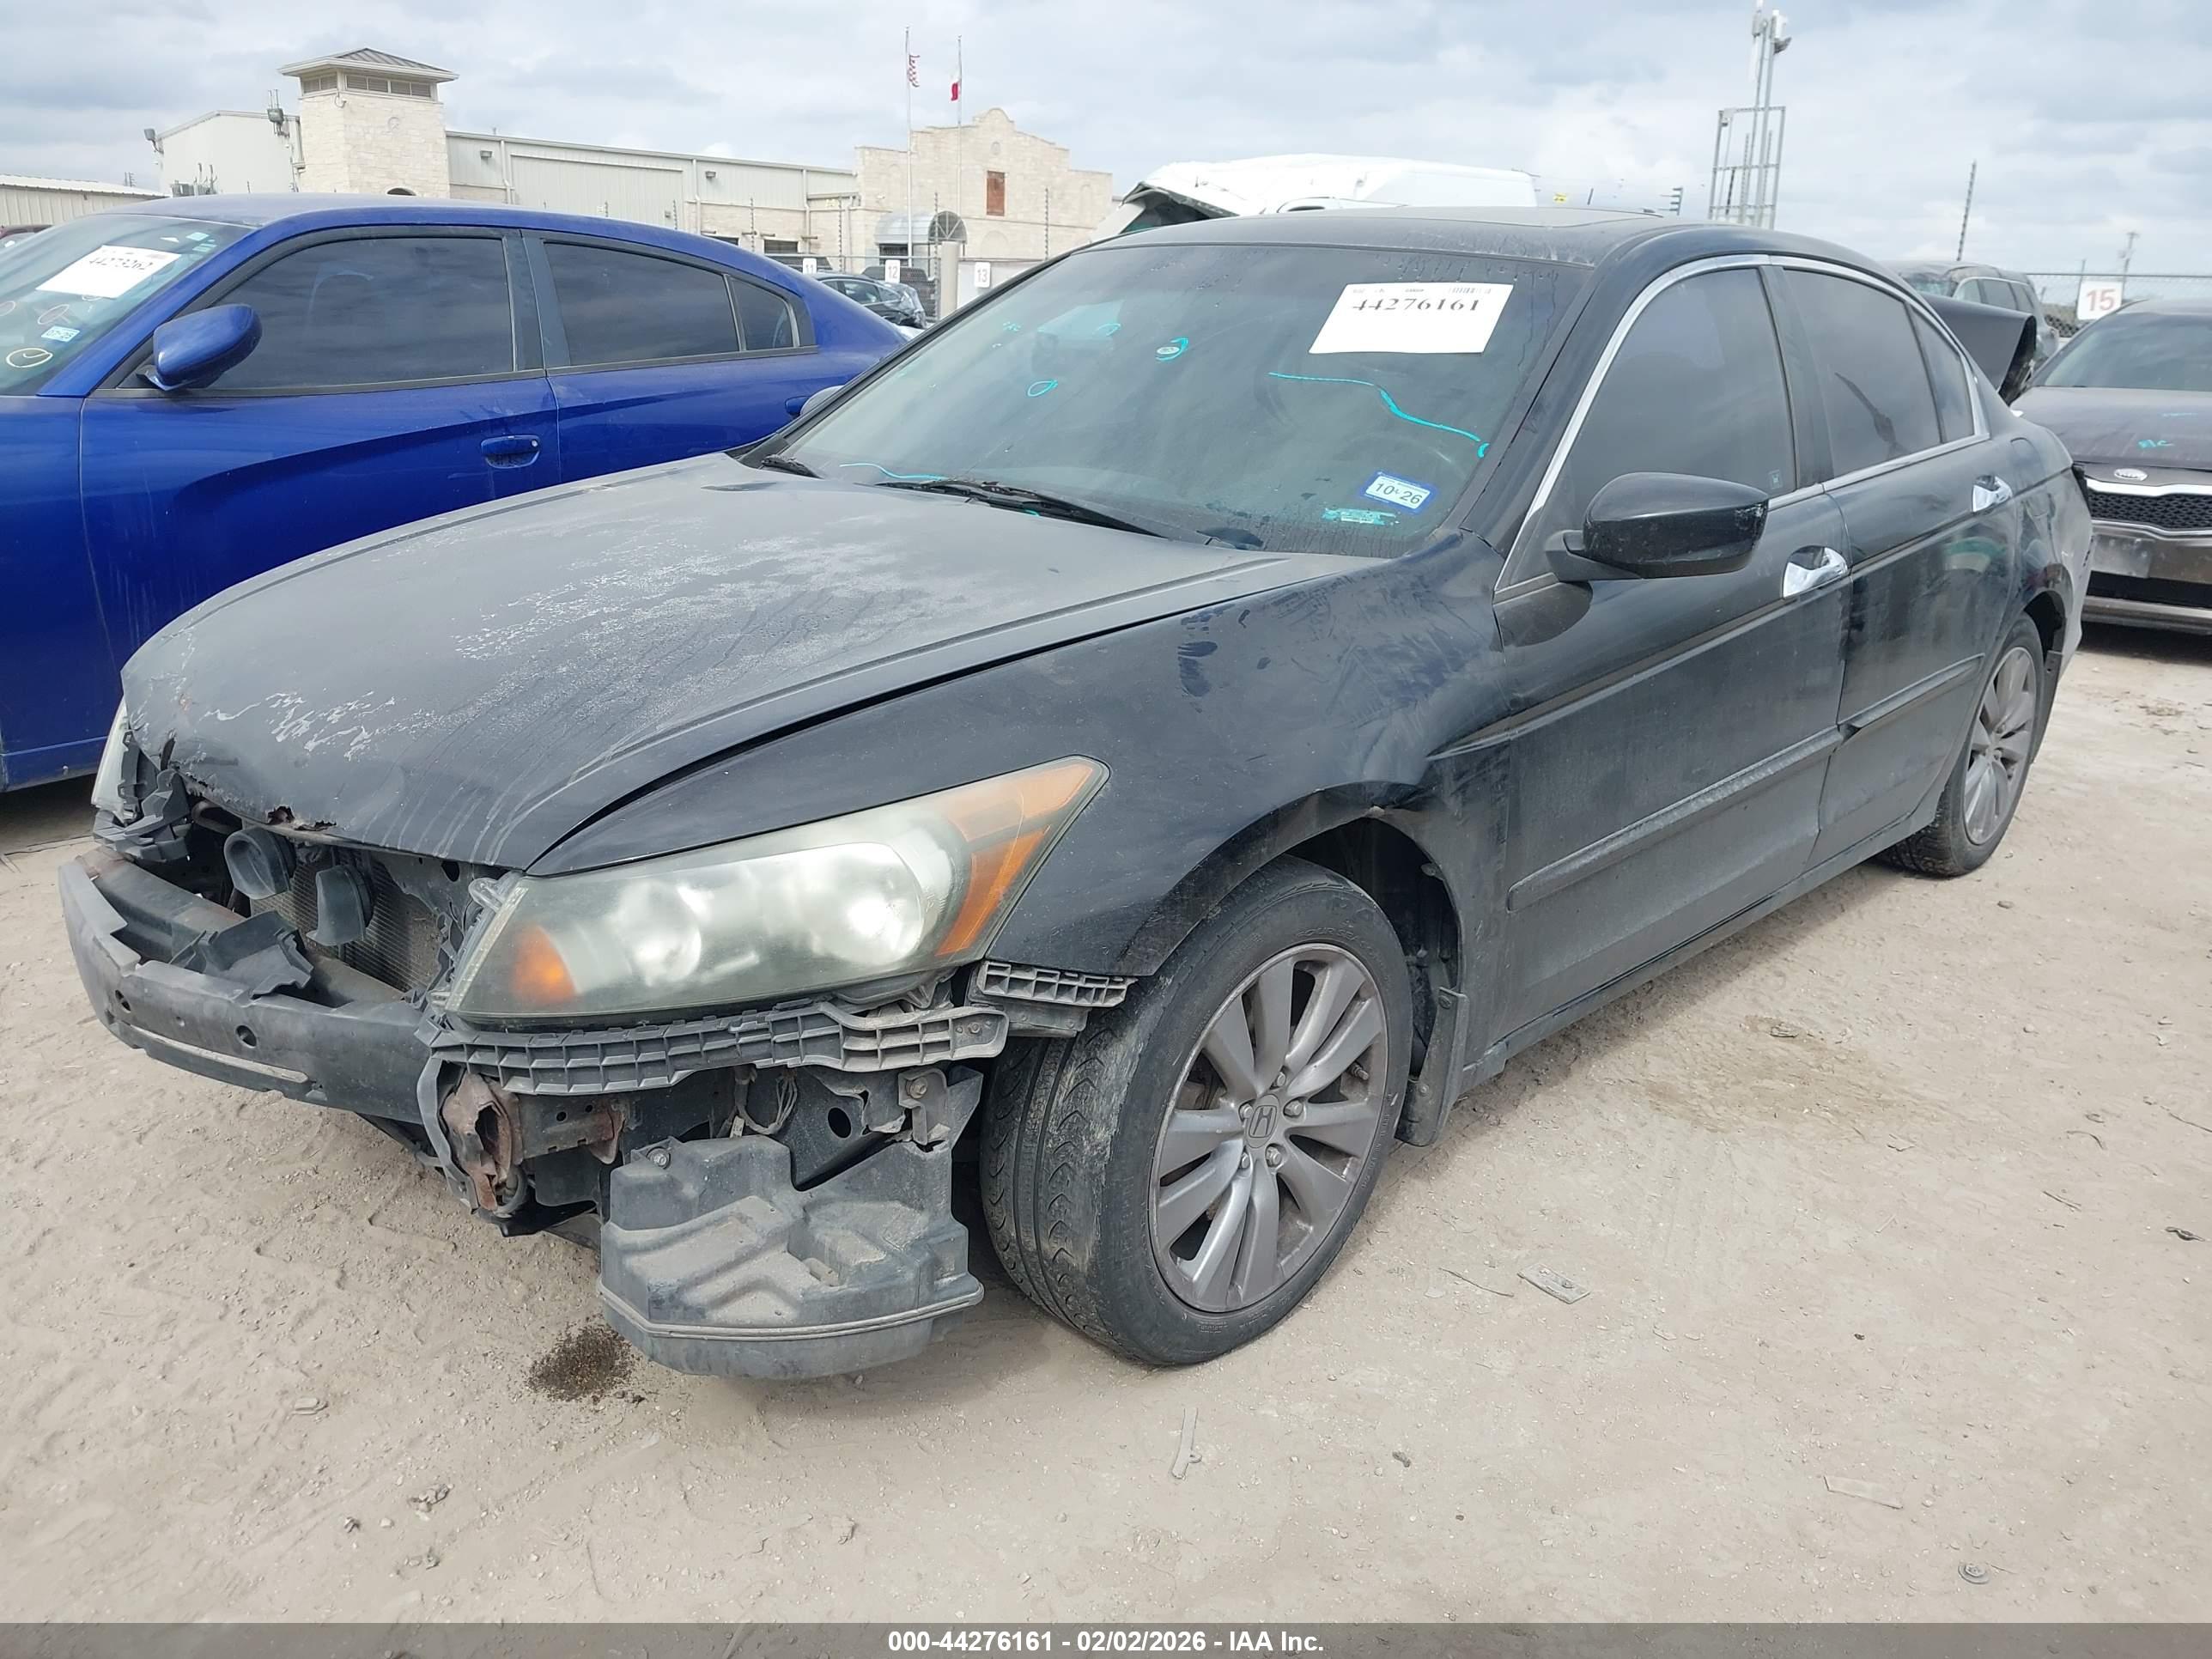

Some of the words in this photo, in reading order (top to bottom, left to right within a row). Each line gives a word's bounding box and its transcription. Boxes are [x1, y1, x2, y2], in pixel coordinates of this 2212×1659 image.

[888, 265, 898, 279] 12
[977, 269, 988, 283] 13
[1352, 298, 1479, 312] 44276161
[2087, 288, 2116, 311] 15
[1376, 483, 1395, 495] 10
[1399, 490, 1423, 504] 26
